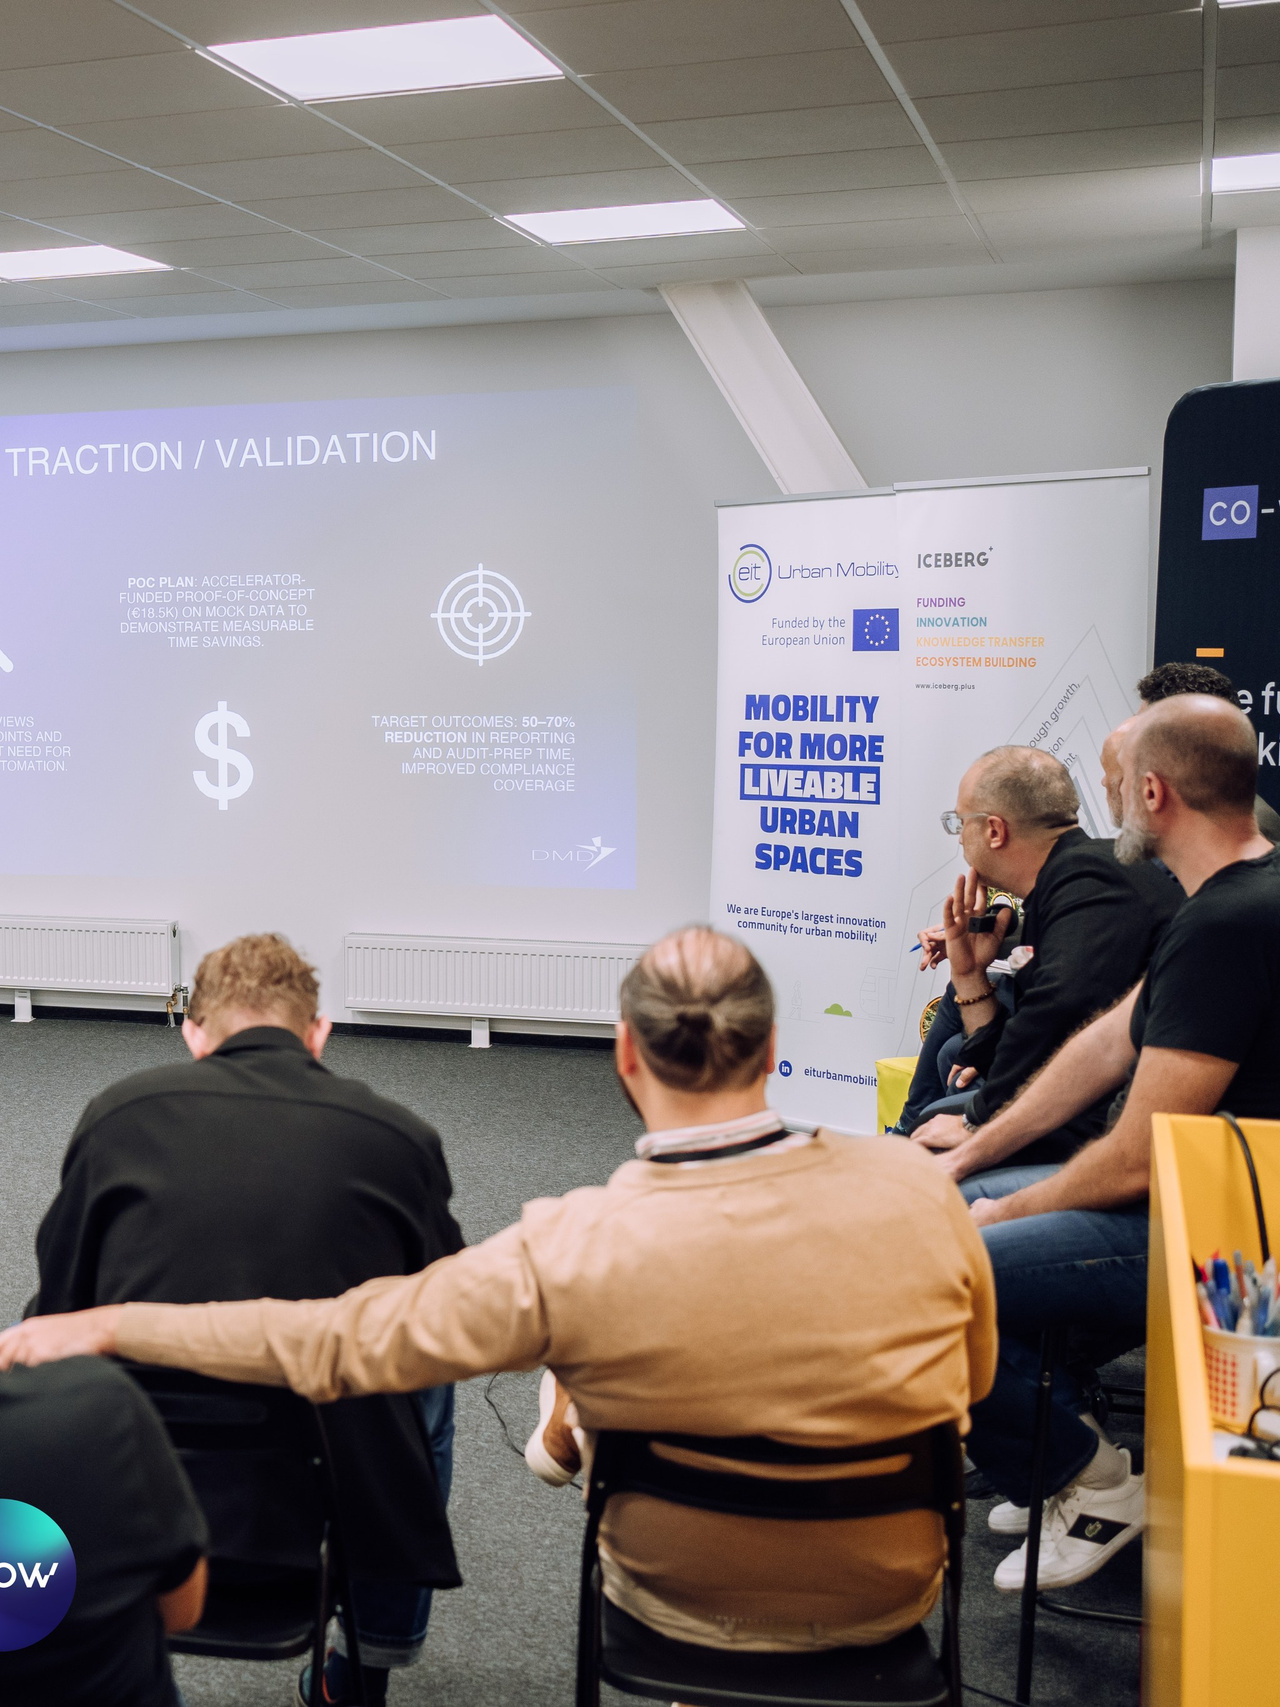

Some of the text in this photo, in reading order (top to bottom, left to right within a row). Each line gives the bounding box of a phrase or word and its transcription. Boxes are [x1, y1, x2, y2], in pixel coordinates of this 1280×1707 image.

[5, 430, 437, 477] TRACTION / VALIDATION
[738, 563, 761, 581] eit
[777, 564, 832, 579] Urban
[128, 574, 306, 588] POC PLAN: ACCELERATOR-
[119, 588, 315, 604] FUNDED PROOF-OF-CONCEPT
[916, 597, 966, 608] FUNDING
[127, 604, 307, 620] (€18.5K) ON MOCK DATA TO
[120, 619, 314, 633] DEMONSTRATE MEASURABLE
[772, 616, 846, 630] Funded by the
[916, 617, 987, 627] INNOVATION
[168, 636, 264, 648] TIME SAVINGS.
[762, 634, 845, 647] European Union
[916, 636, 1045, 647] KNOWLEDGE TRANSFER
[916, 657, 1037, 668] ECOSYSTEM BUILDING
[915, 683, 975, 691] www.iceberg.plus
[745, 694, 880, 723] MOBILITY
[1050, 683, 1081, 722] growth,
[372, 716, 427, 728] TARGET
[432, 716, 518, 728] OUTCOMES:
[35, 731, 62, 742] AND
[384, 732, 575, 744] REDUCTION IN REPORTING
[8, 746, 42, 757] NEED
[45, 746, 71, 757] FOR
[738, 731, 884, 762] FOR MORE
[413, 748, 575, 762] AND AUDIT-PREP TIME,
[401, 762, 575, 775] IMPROVED COMPLIANCE
[493, 779, 575, 792] COVERAGE
[744, 768, 877, 802] LIVEABLE
[759, 806, 860, 839] URBAN
[532, 849, 594, 862] DMD
[755, 843, 863, 878] SPACES
[726, 903, 886, 929] We are Europe's largest innovation
[737, 920, 877, 944] community for urban mobility!
[804, 1067, 878, 1087] eiturbanmobilit
